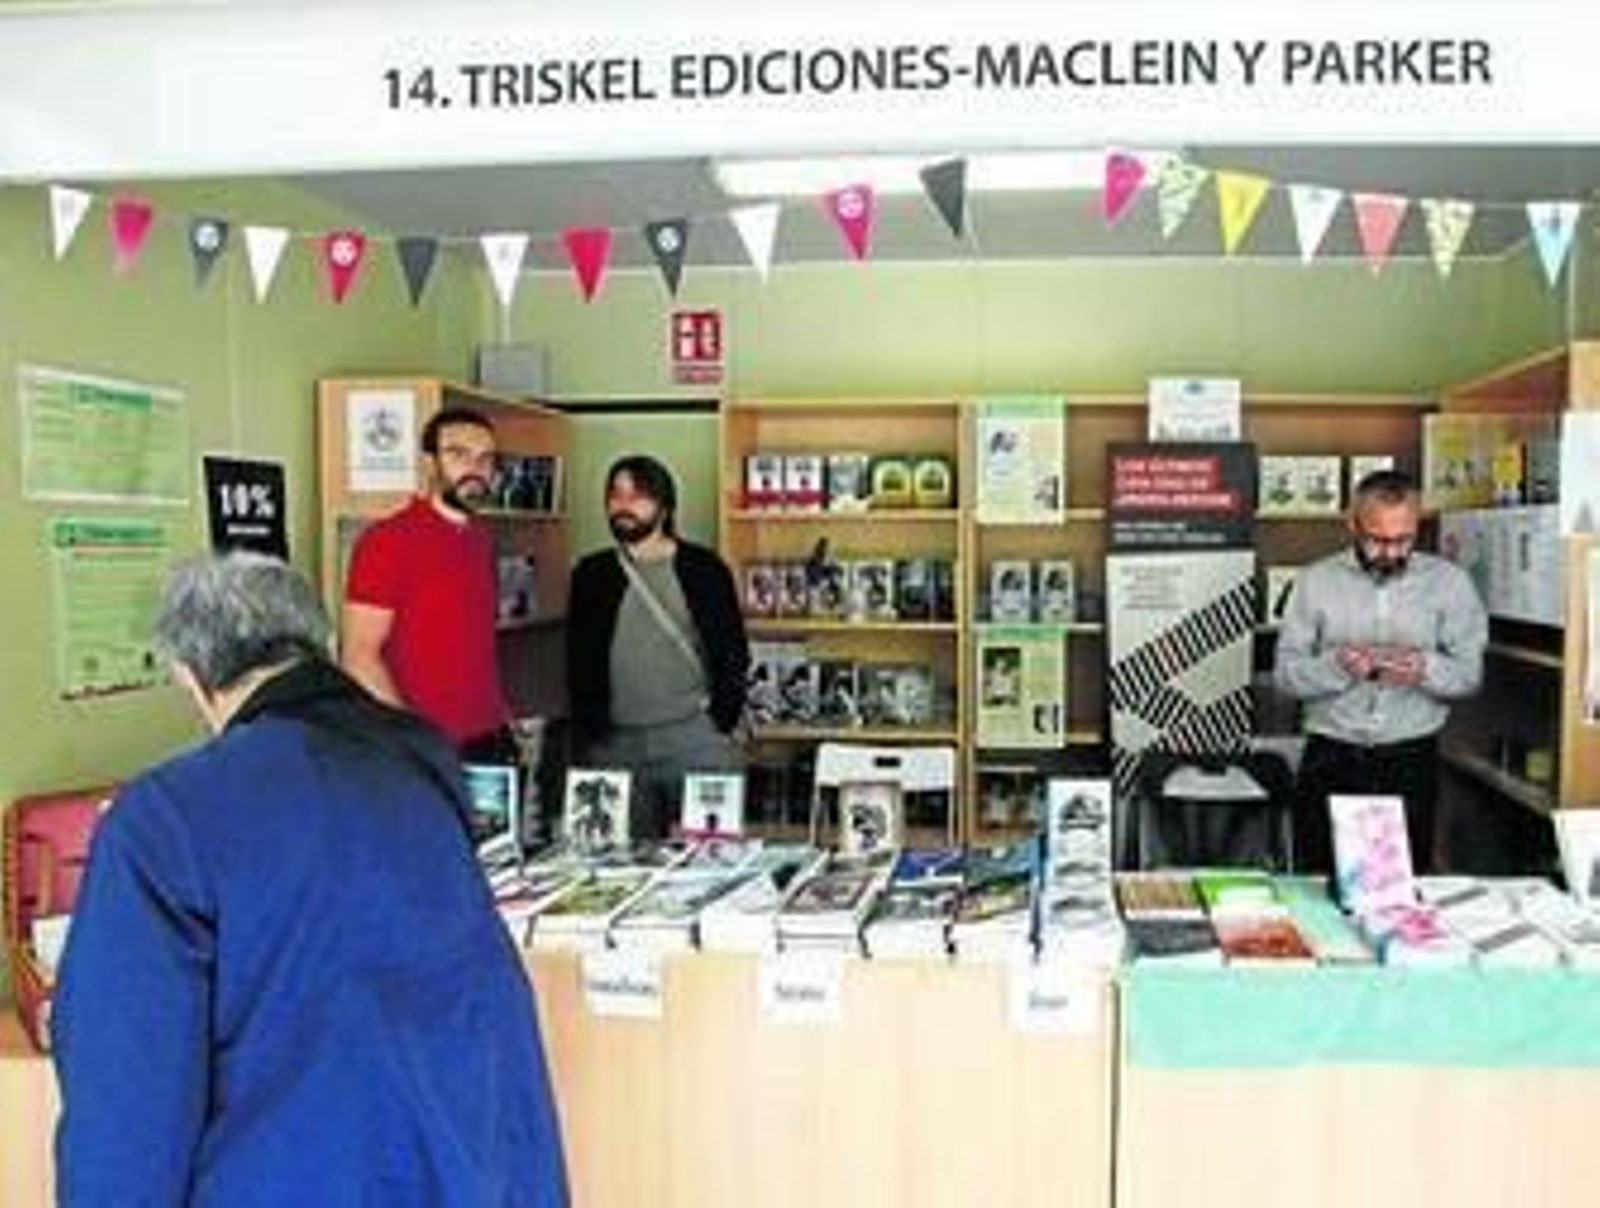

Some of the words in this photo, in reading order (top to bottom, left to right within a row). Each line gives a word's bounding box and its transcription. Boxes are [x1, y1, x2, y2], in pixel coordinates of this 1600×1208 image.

[383, 67, 453, 109] 14.
[462, 57, 656, 106] TRISKEL
[670, 42, 1218, 99] EDICIONES-MACLEIN
[1232, 41, 1267, 85] Y
[1282, 40, 1493, 84] PARKER
